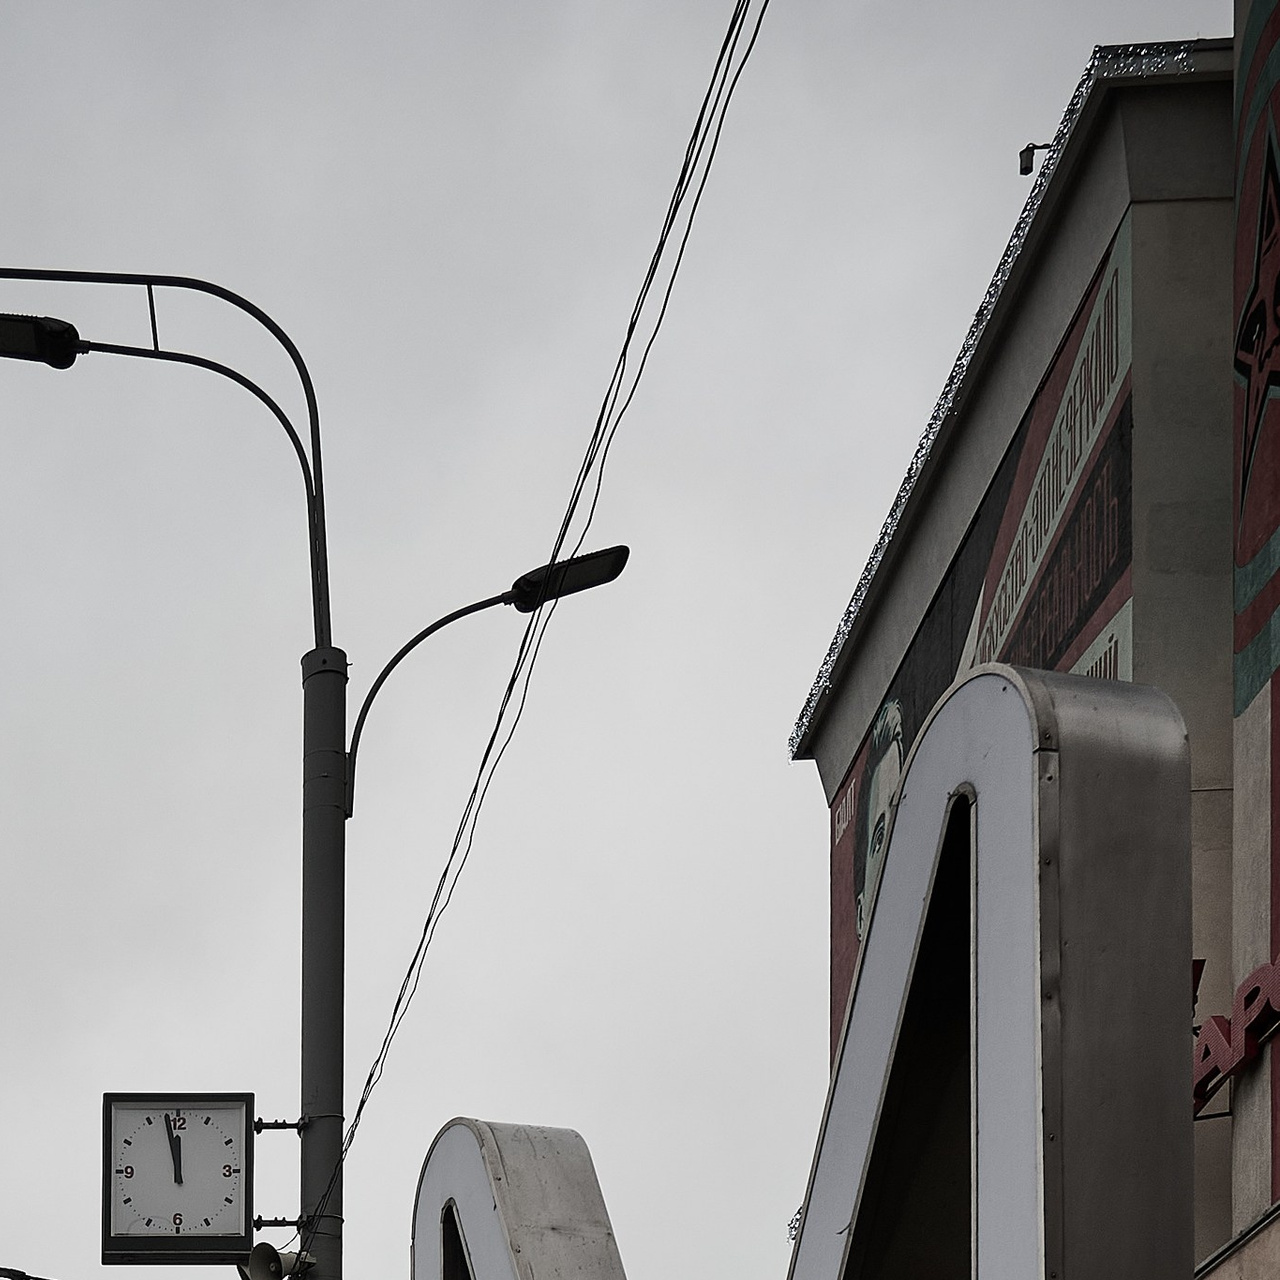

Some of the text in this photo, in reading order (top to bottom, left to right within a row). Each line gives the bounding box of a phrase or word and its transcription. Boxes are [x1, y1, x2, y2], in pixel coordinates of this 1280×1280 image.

[1193, 955, 1280, 1093] АР
[170, 1117, 187, 1131] 12
[124, 1164, 233, 1179] 9 3
[172, 1213, 183, 1226] 6
